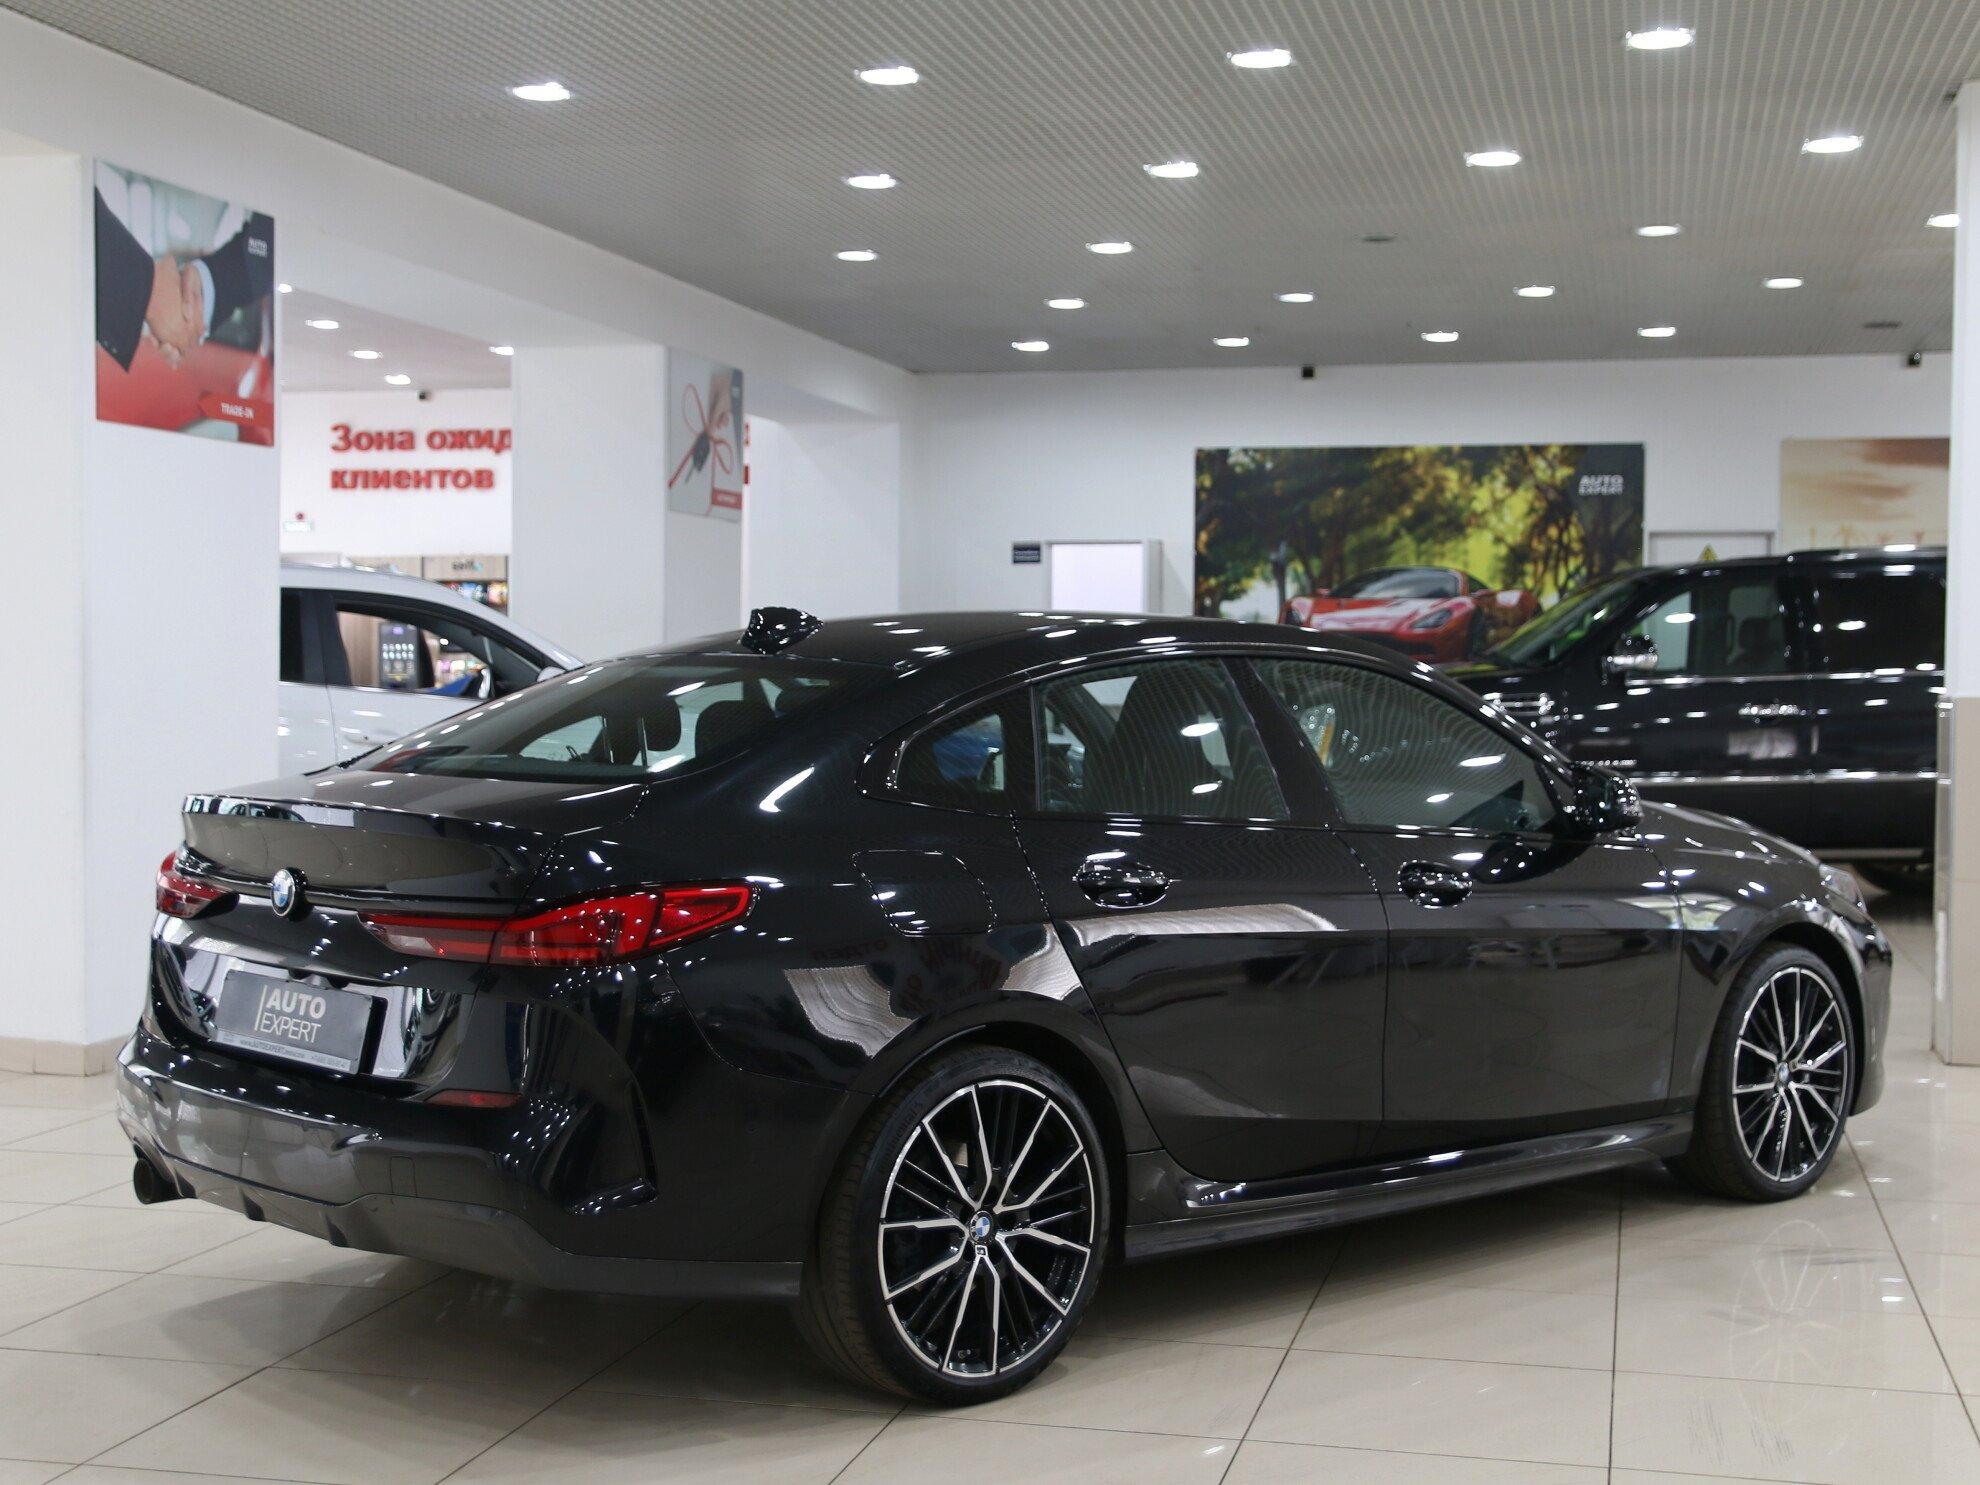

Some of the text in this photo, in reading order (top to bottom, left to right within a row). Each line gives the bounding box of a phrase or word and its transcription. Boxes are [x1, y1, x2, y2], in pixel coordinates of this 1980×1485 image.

[330, 422, 415, 452] Зона
[330, 468, 495, 490] клиентов
[1580, 475, 1624, 486] AUTO
[266, 988, 326, 1019] AUTO
[260, 1013, 321, 1043] EXPERT
